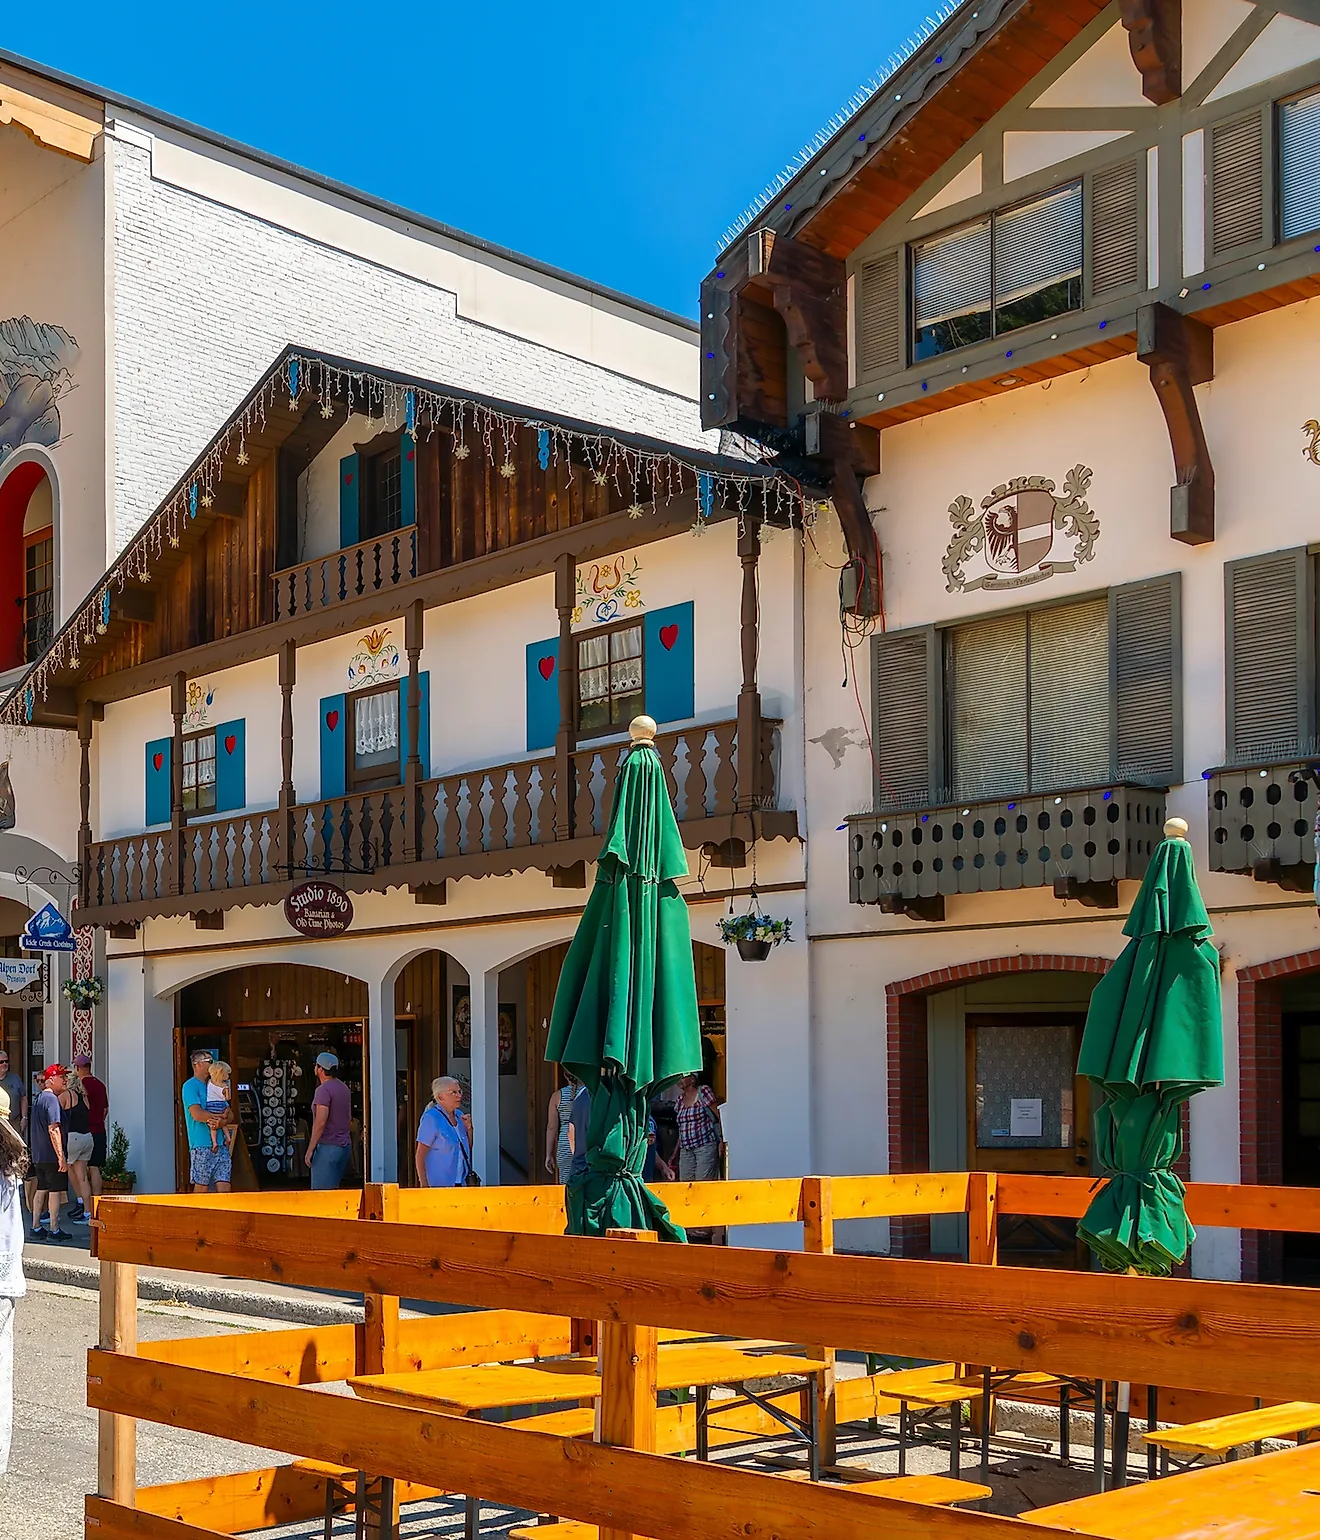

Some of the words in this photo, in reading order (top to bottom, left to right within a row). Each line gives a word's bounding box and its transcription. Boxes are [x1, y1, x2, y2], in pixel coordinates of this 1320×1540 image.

[291, 885, 324, 912] Studio
[327, 889, 348, 912] 1890
[304, 908, 330, 918] Bavarian
[295, 917, 308, 927] Old
[308, 918, 323, 928] Time
[323, 918, 345, 930] Photos
[39, 939, 52, 947] Creek
[53, 940, 73, 949] Clothing
[19, 963, 36, 974] Dorf
